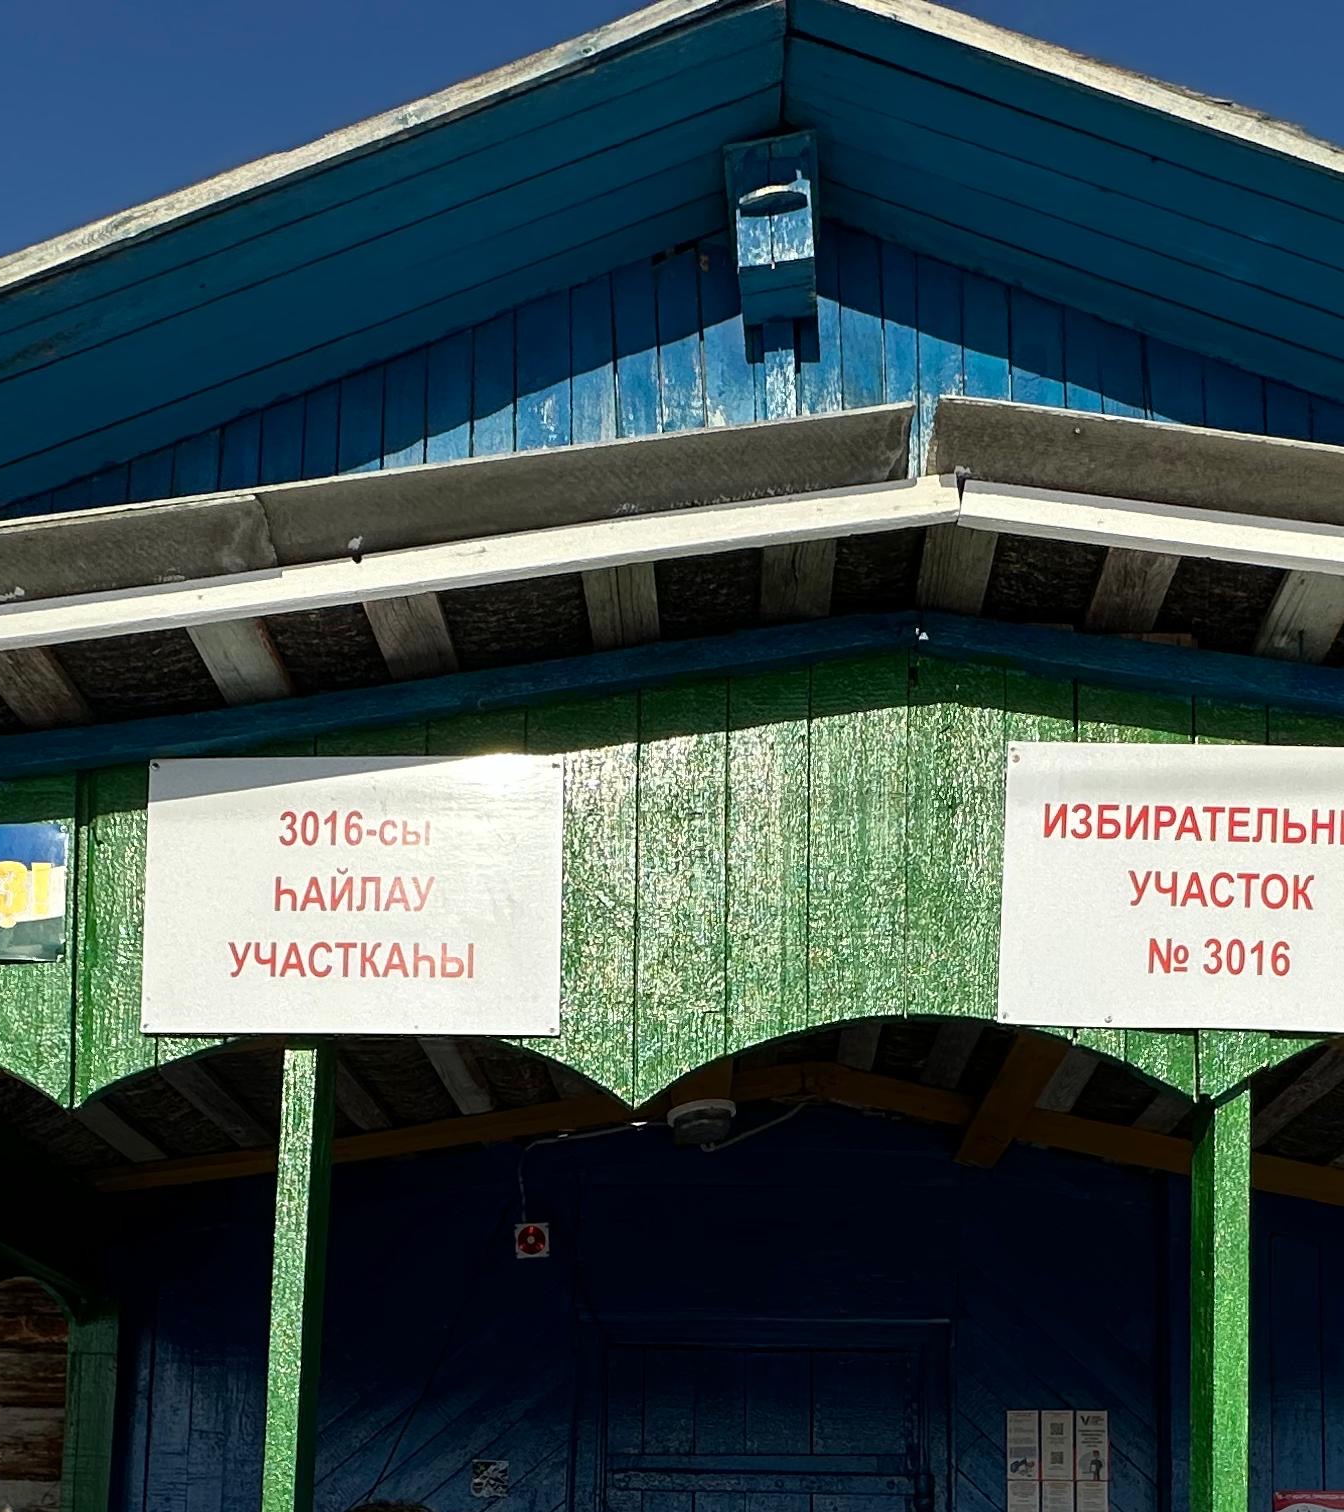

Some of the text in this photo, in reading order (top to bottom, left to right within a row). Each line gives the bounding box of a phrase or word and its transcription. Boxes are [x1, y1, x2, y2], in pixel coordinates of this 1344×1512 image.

[279, 810, 431, 846] 3016-сы
[1128, 870, 1314, 910] УЧАСТОК
[1148, 938, 1291, 976] № 3016
